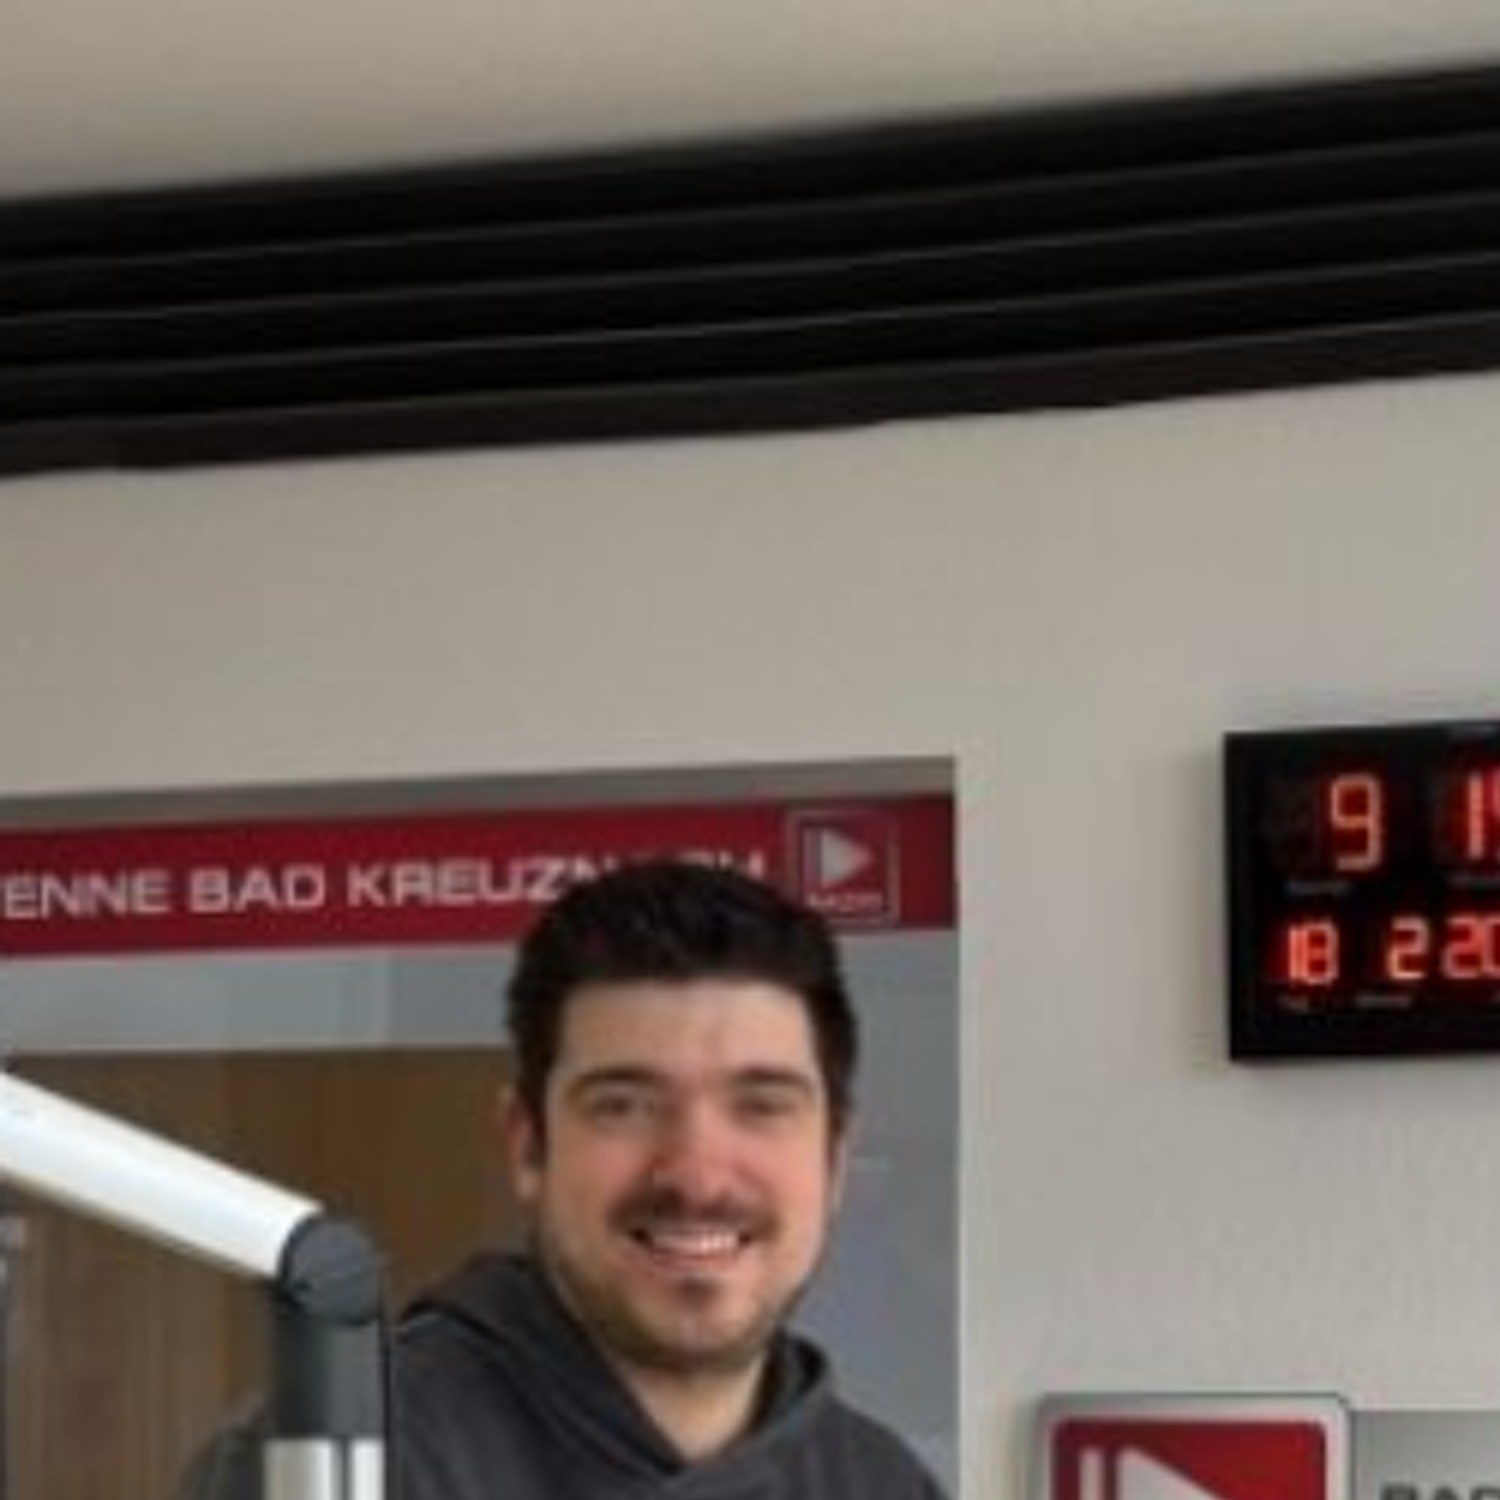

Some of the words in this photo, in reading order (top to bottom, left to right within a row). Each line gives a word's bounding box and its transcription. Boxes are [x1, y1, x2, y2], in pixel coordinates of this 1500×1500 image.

[1329, 773, 1382, 871] 9
[2, 866, 172, 920] ENNE
[189, 863, 327, 914] BAD
[346, 850, 768, 908] KREUZ
[1287, 918, 1339, 986] 18
[1387, 916, 1430, 980] 2
